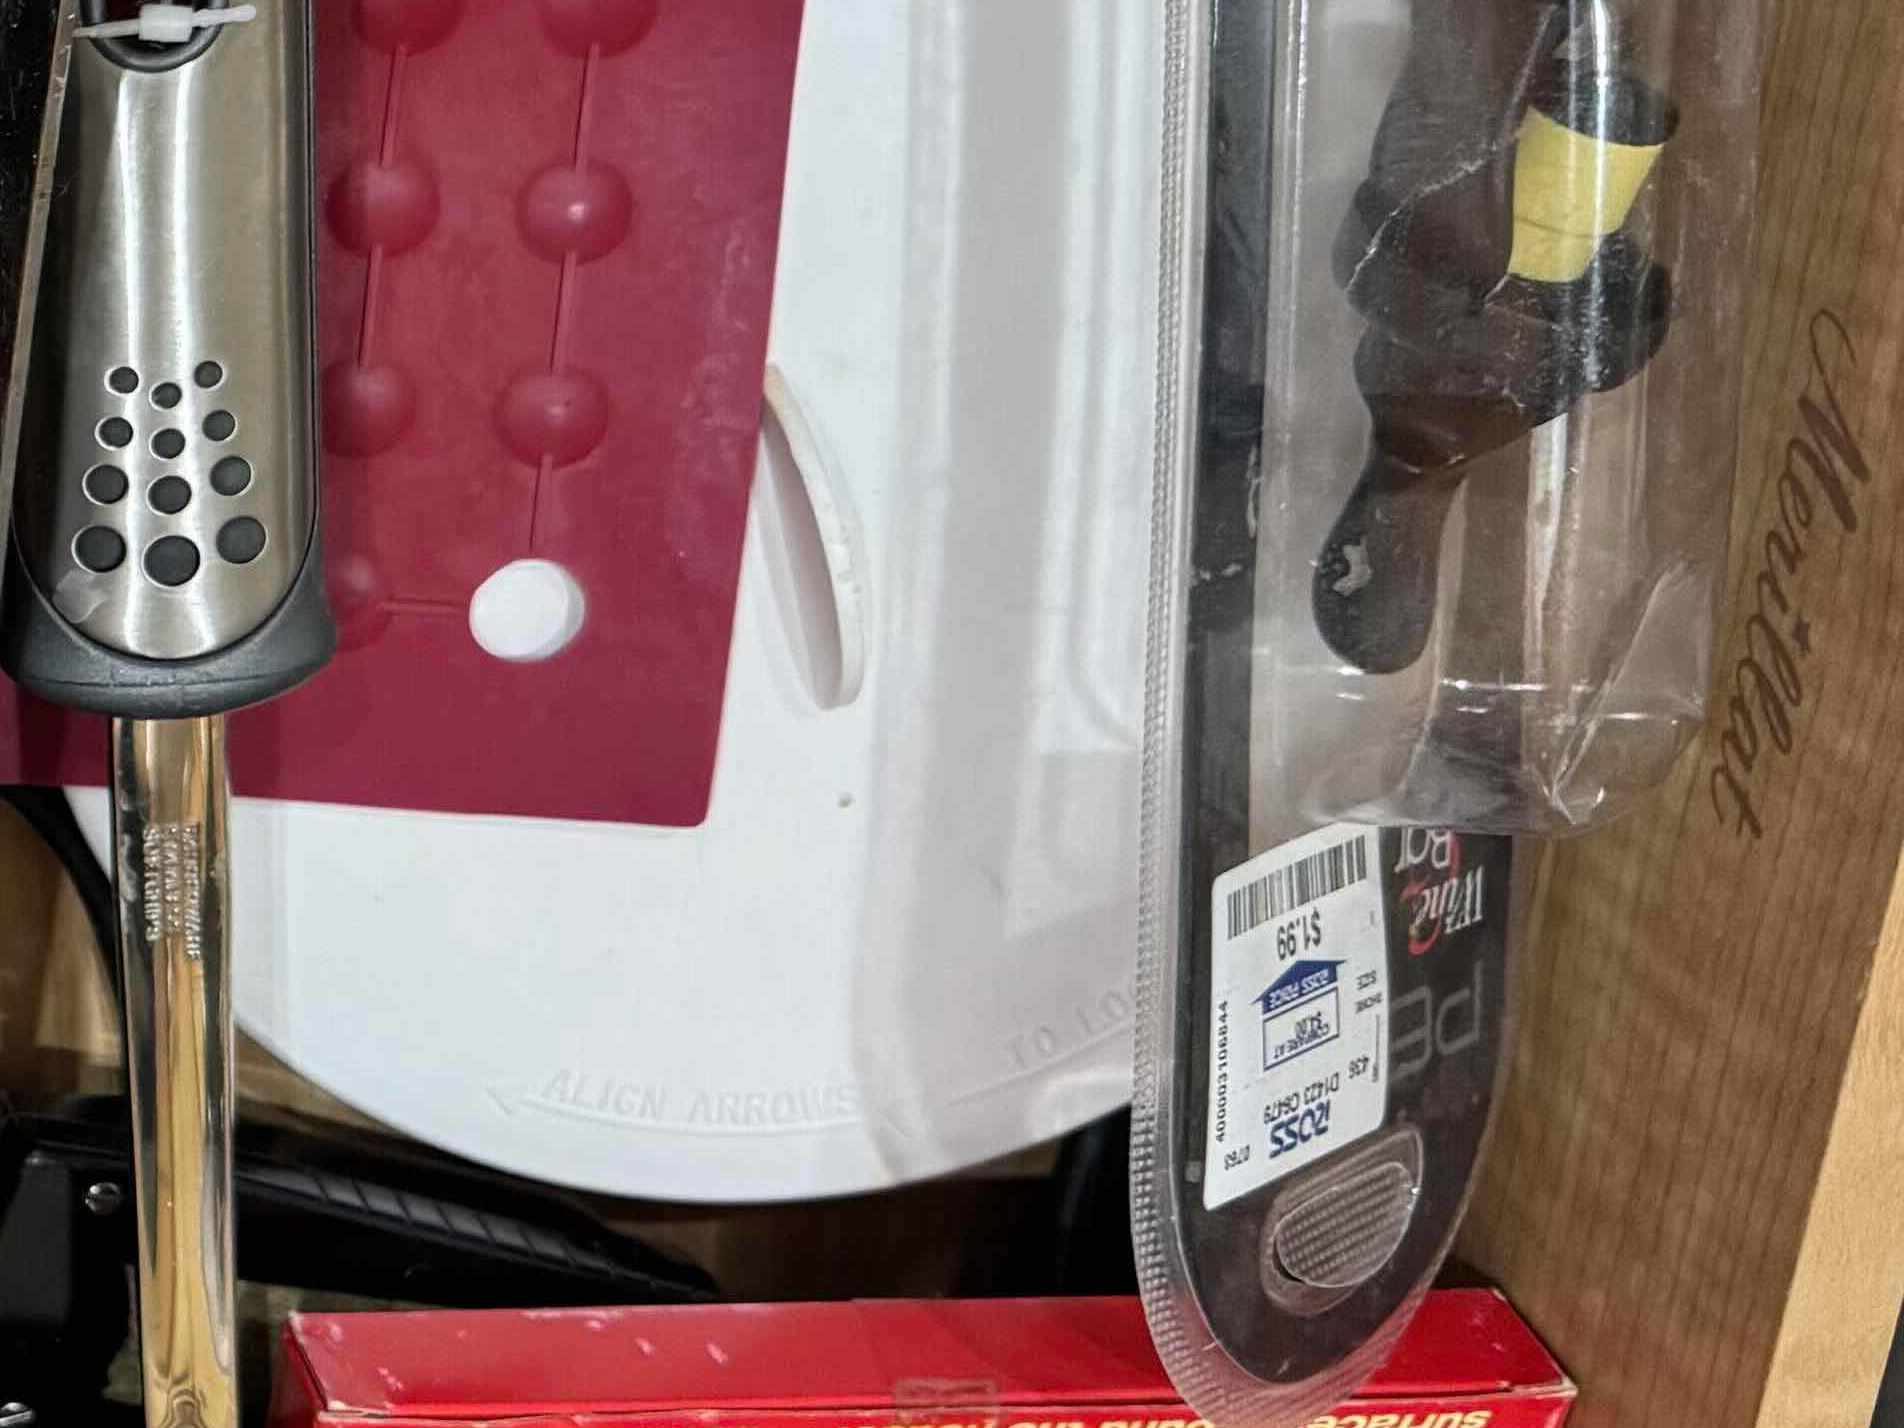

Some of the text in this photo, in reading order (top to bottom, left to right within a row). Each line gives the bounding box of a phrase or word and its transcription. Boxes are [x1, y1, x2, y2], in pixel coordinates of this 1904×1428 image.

[1402, 865, 1483, 934] Wine
[1276, 907, 1322, 961] $1.99
[1273, 1045, 1289, 1059] AT
[1392, 960, 1490, 1087] PE
[541, 1066, 665, 1120] ALIGN
[1269, 1098, 1330, 1159] ROSS
